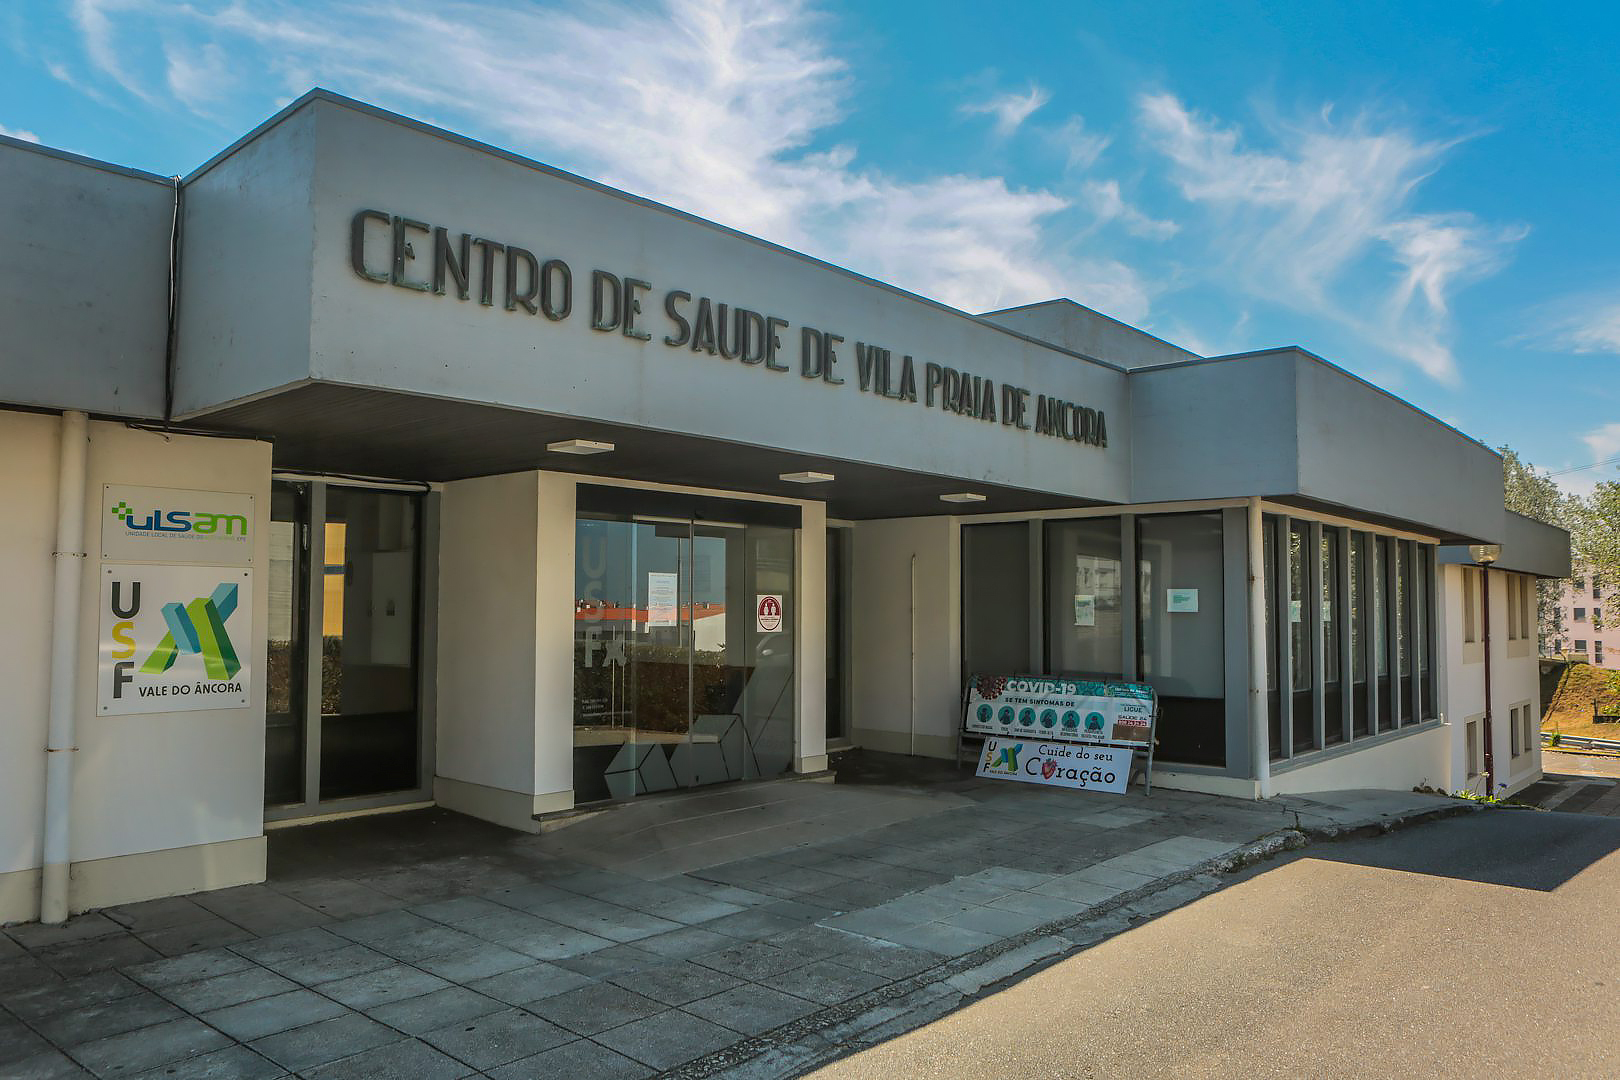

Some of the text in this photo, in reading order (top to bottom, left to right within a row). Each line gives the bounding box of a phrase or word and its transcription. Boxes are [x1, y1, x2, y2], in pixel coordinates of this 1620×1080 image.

[351, 208, 1109, 449] CENTRO DE SAUDE DE VILA PRAIA DE ANCORA
[139, 682, 242, 697] VALE DO ÂNCORA
[1006, 680, 1077, 696] COVID-19
[1030, 698, 1063, 706] SINTOMAS
[1038, 744, 1113, 762] Cuide do seu
[1025, 757, 1116, 787] Cração
